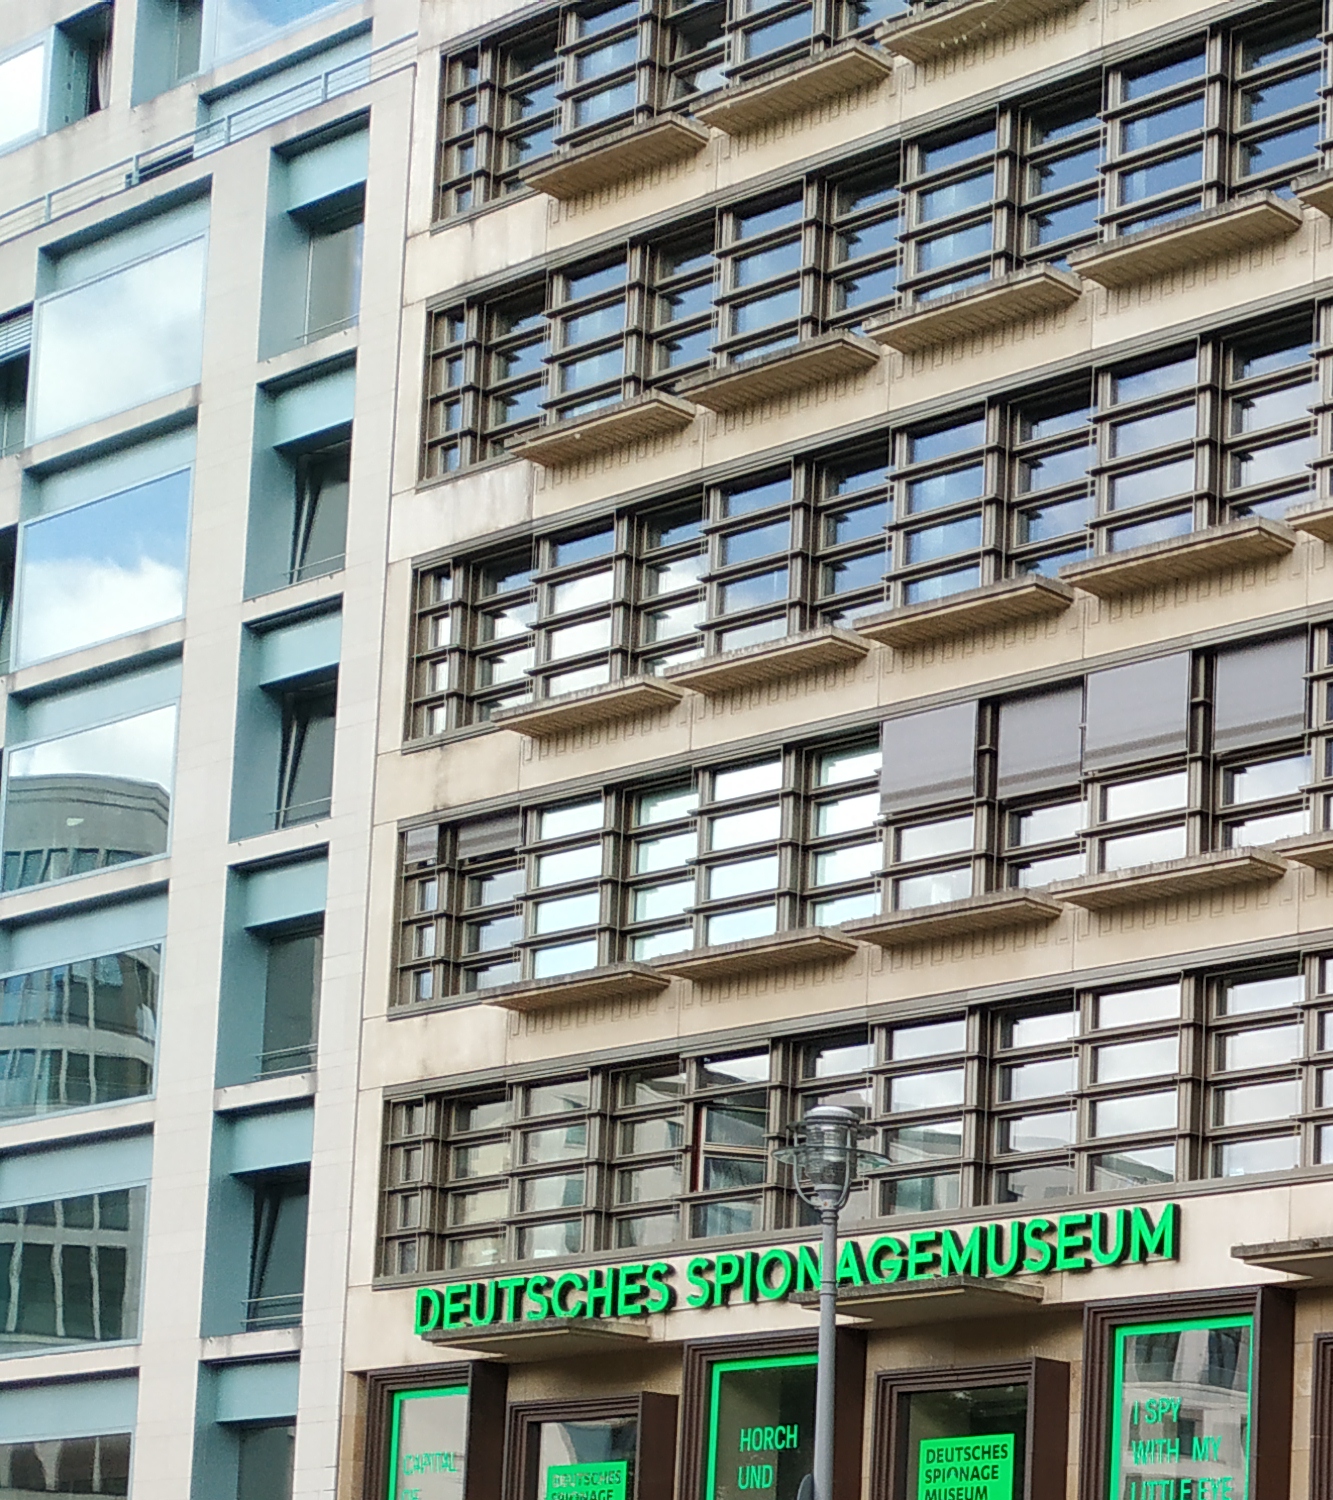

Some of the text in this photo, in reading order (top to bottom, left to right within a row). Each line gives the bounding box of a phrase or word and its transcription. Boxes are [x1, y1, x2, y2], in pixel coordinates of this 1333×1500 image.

[414, 1203, 1176, 1335] DEUTSCHES SPIONAGEMUSEUM
[1133, 1396, 1182, 1425] I SPY
[740, 1424, 798, 1452] HORCH
[1131, 1435, 1222, 1465] WITH MY
[403, 1451, 457, 1475] CAPITAL
[926, 1444, 1009, 1464] DEUTSCHES
[551, 1469, 622, 1488] DEUTSCHES
[738, 1465, 773, 1489] UND
[924, 1465, 999, 1484] SPIONAGE
